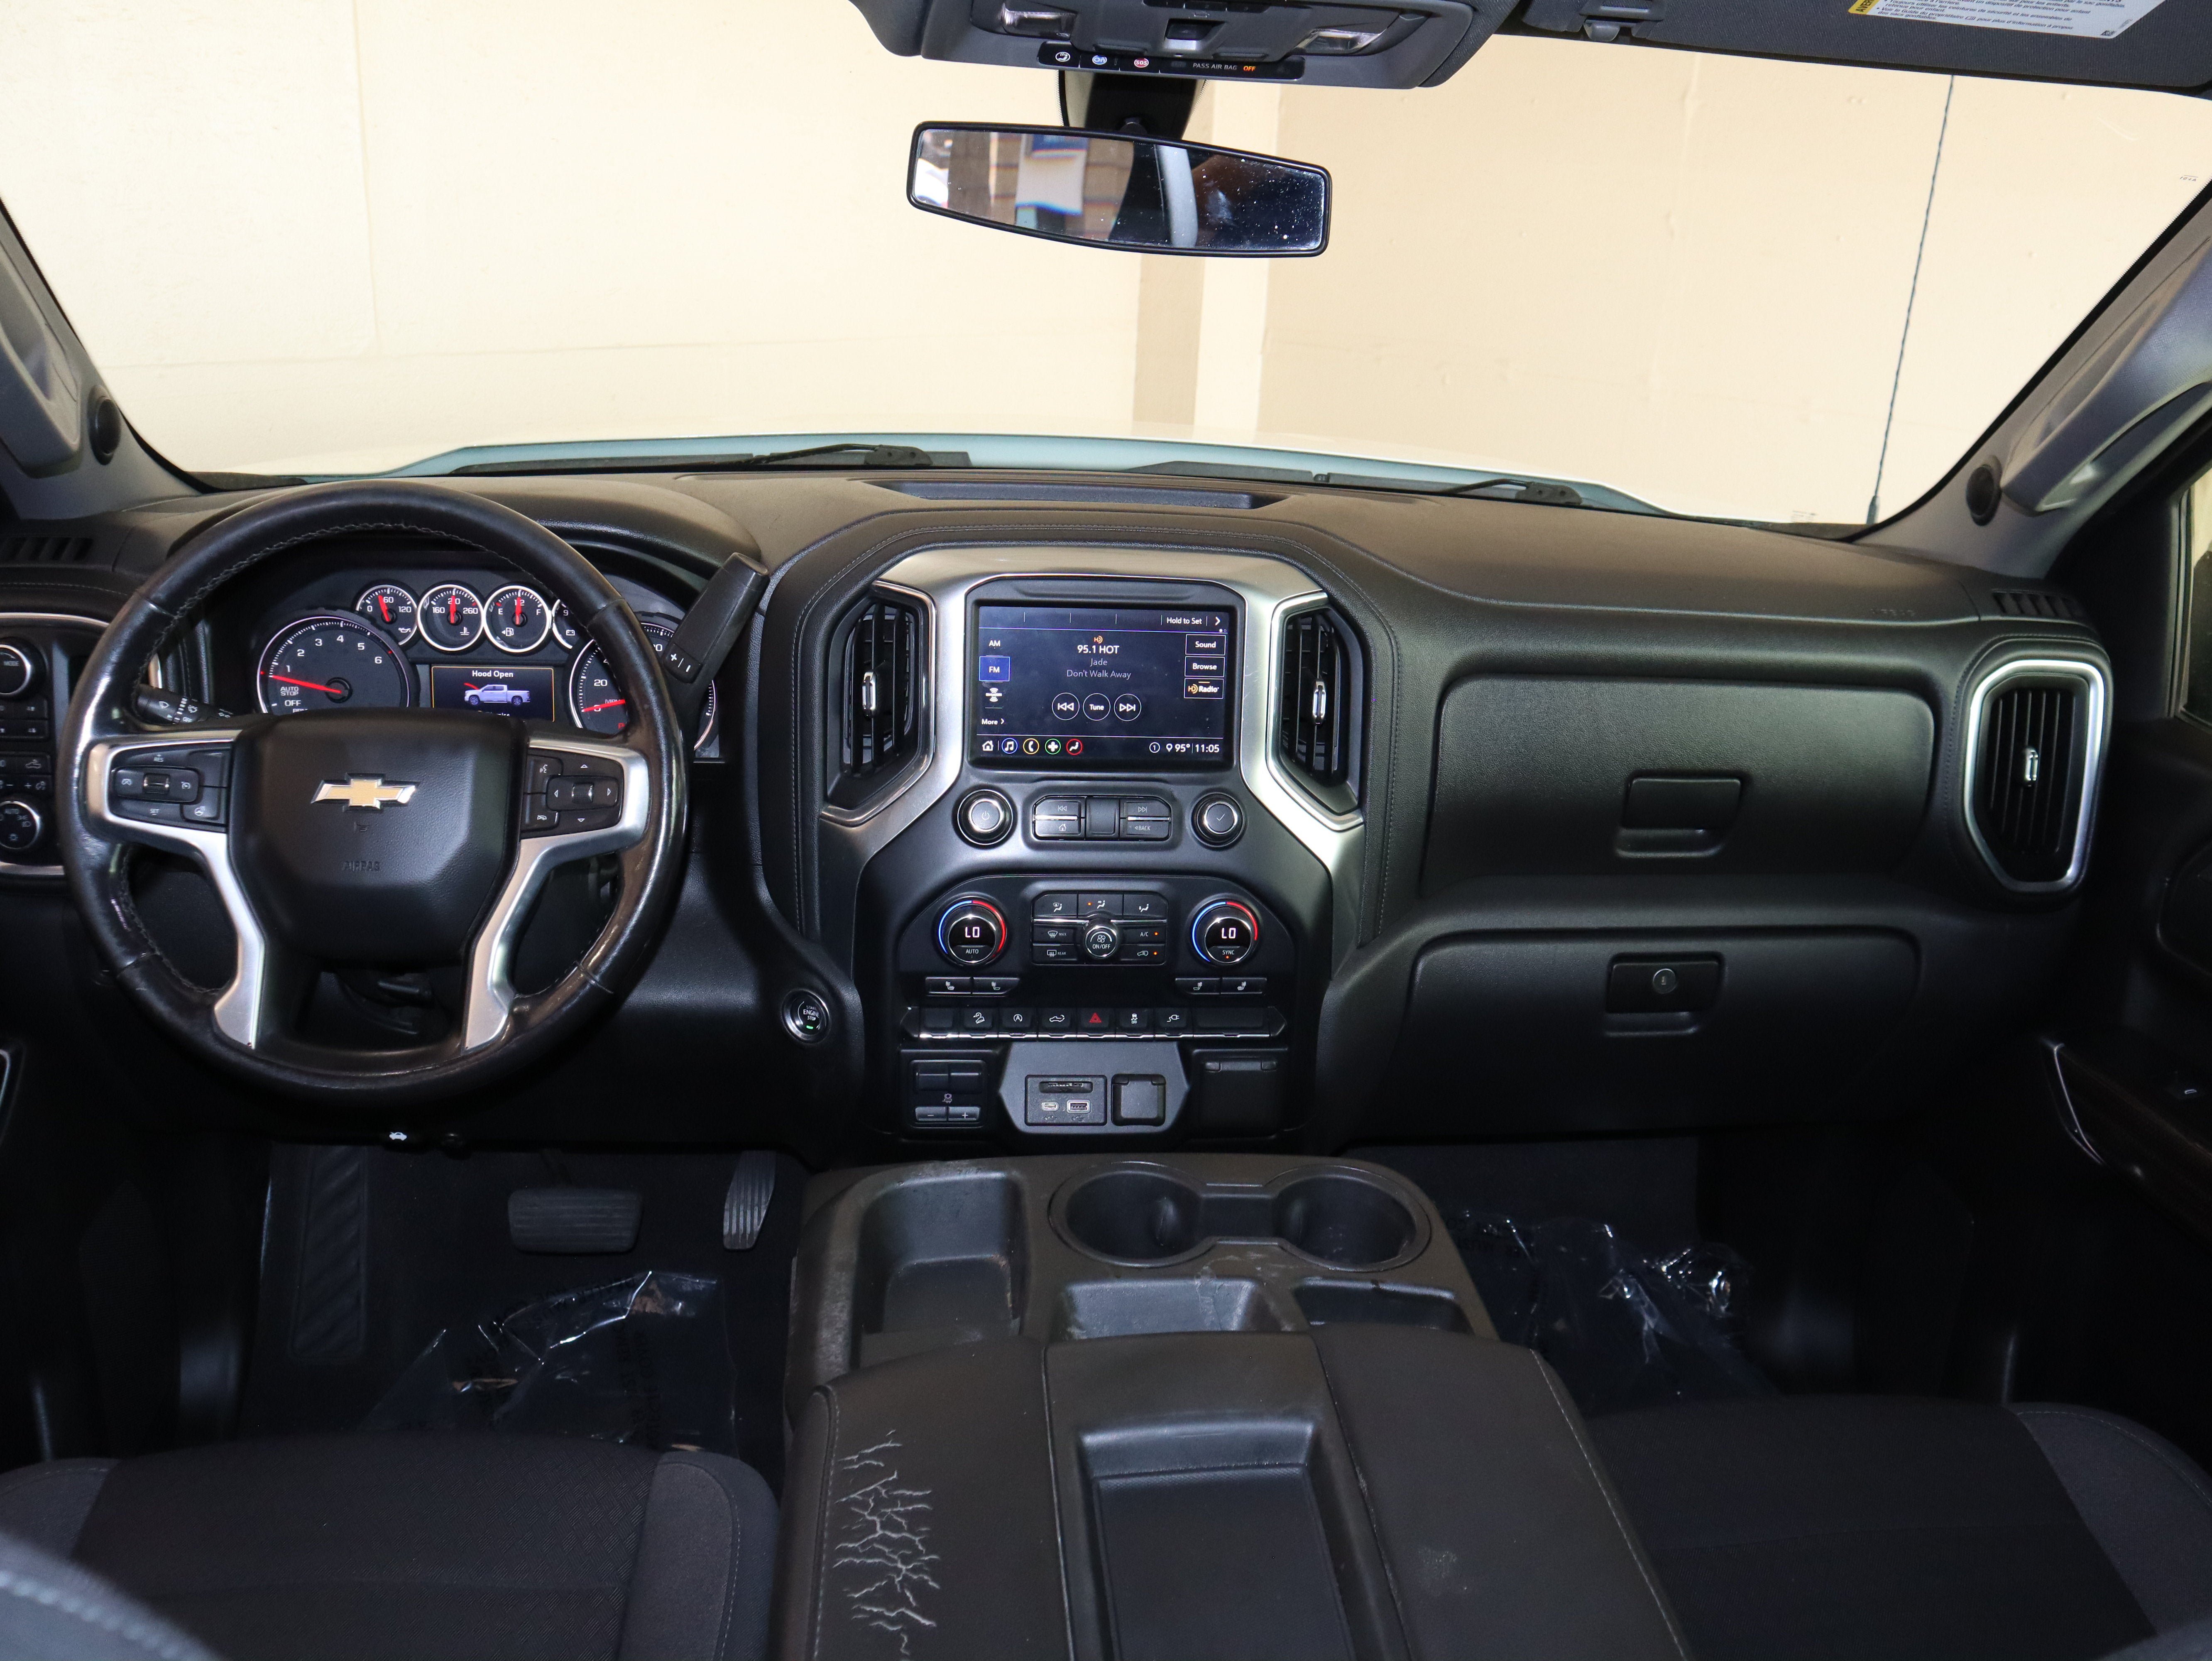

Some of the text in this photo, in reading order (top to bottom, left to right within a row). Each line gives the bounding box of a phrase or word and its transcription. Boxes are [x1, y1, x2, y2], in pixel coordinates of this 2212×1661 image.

[1077, 644, 1120, 654] 95.1 HOT
[1089, 658, 1108, 667] Jade
[493, 670, 514, 679] Open
[1089, 669, 1108, 678] Walk
[1110, 670, 1131, 680] Away
[1175, 743, 1190, 752] 95°
[1195, 744, 1220, 753] 11:05
[965, 926, 980, 938] LO
[1221, 927, 1236, 939] LO
[803, 1009, 820, 1018] ENGINE
